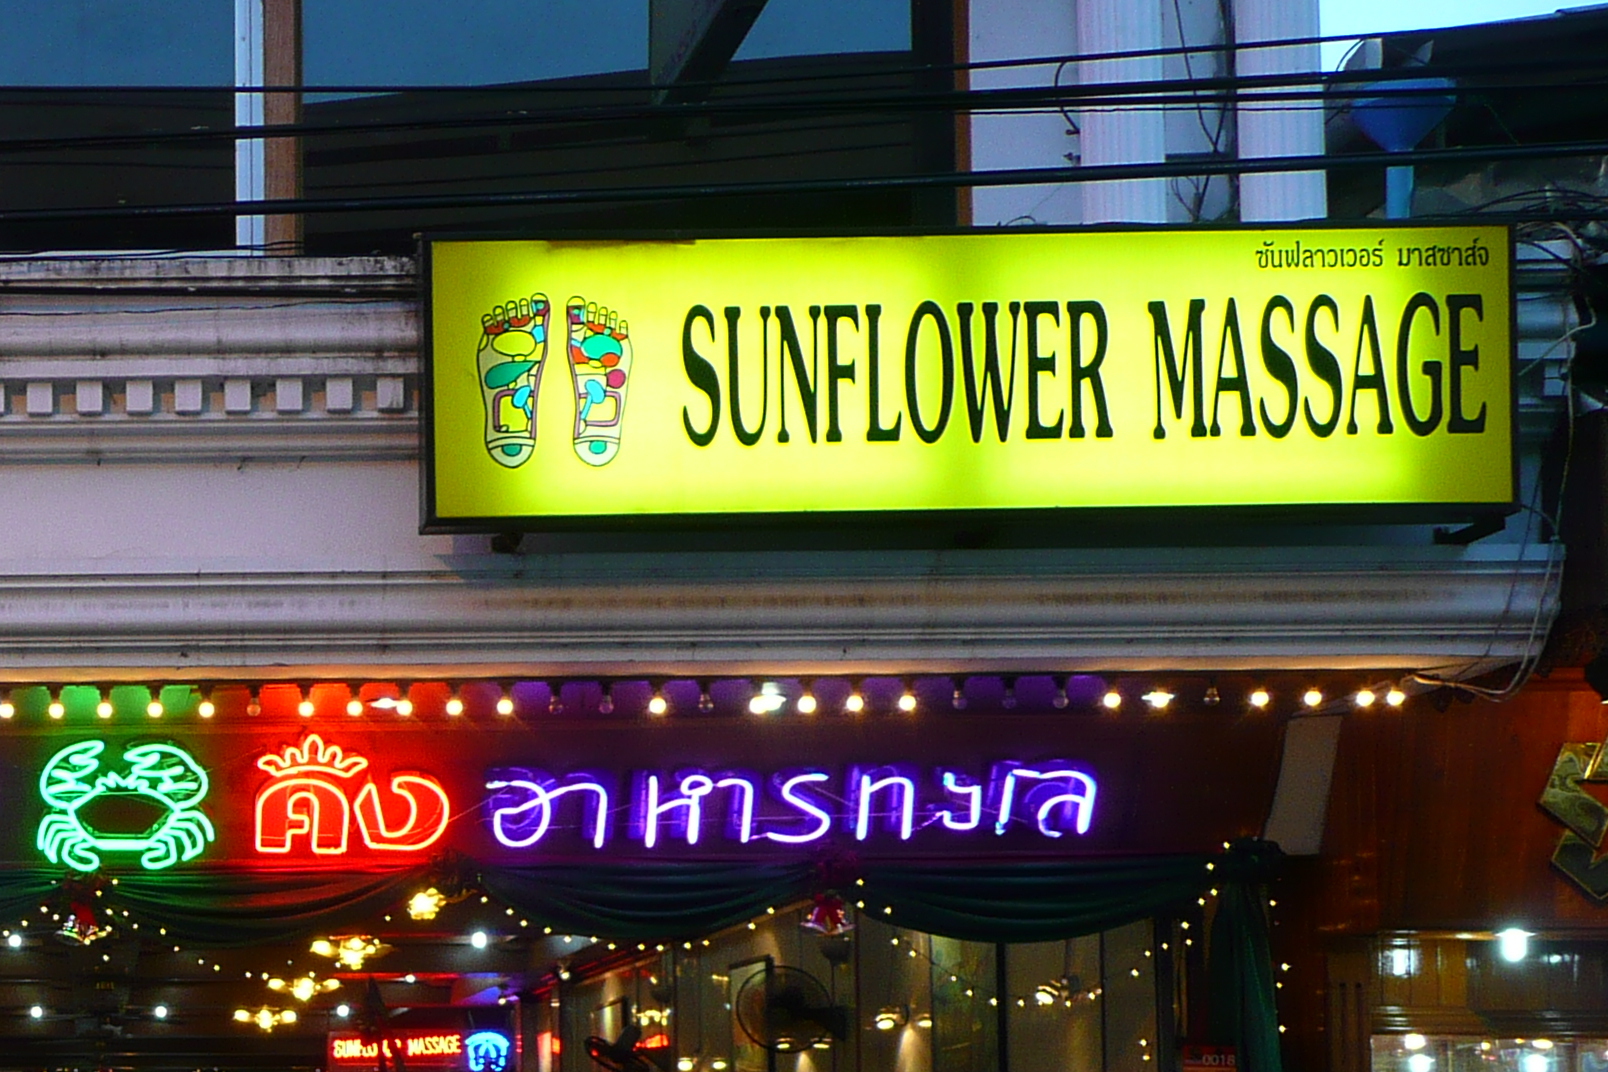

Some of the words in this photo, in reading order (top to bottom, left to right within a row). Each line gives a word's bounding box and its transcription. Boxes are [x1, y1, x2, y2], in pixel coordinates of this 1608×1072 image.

[680, 300, 1114, 447] SUNFLOWER
[1148, 292, 1488, 439] MASSAGE
[255, 733, 452, 853] คิง
[487, 770, 1098, 849] อาหารทะเล
